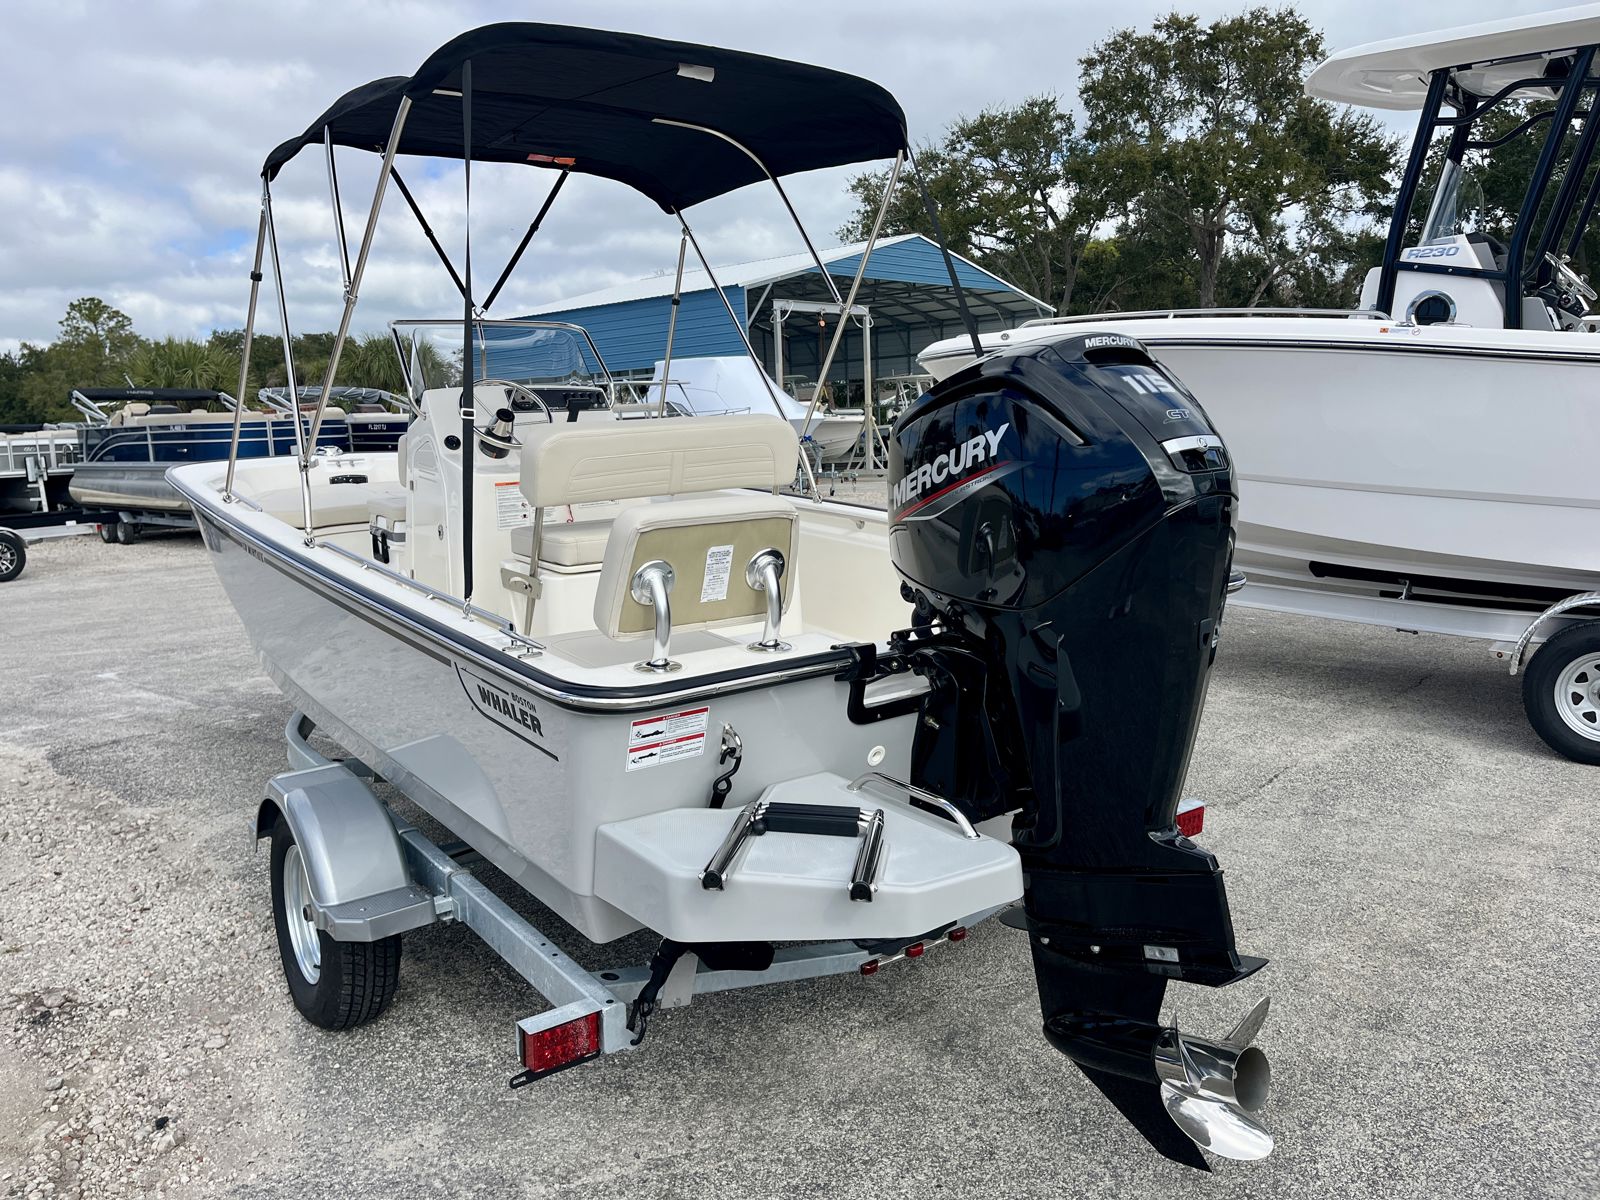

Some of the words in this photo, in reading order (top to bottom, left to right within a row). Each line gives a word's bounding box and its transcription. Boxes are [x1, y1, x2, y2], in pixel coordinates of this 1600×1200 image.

[1407, 246, 1459, 259] R230
[1085, 336, 1135, 348] MERCURY
[1121, 374, 1176, 395] 115
[893, 422, 1010, 511] MERCURY
[477, 684, 544, 737] WHALER
[511, 692, 537, 713] BOSTON
